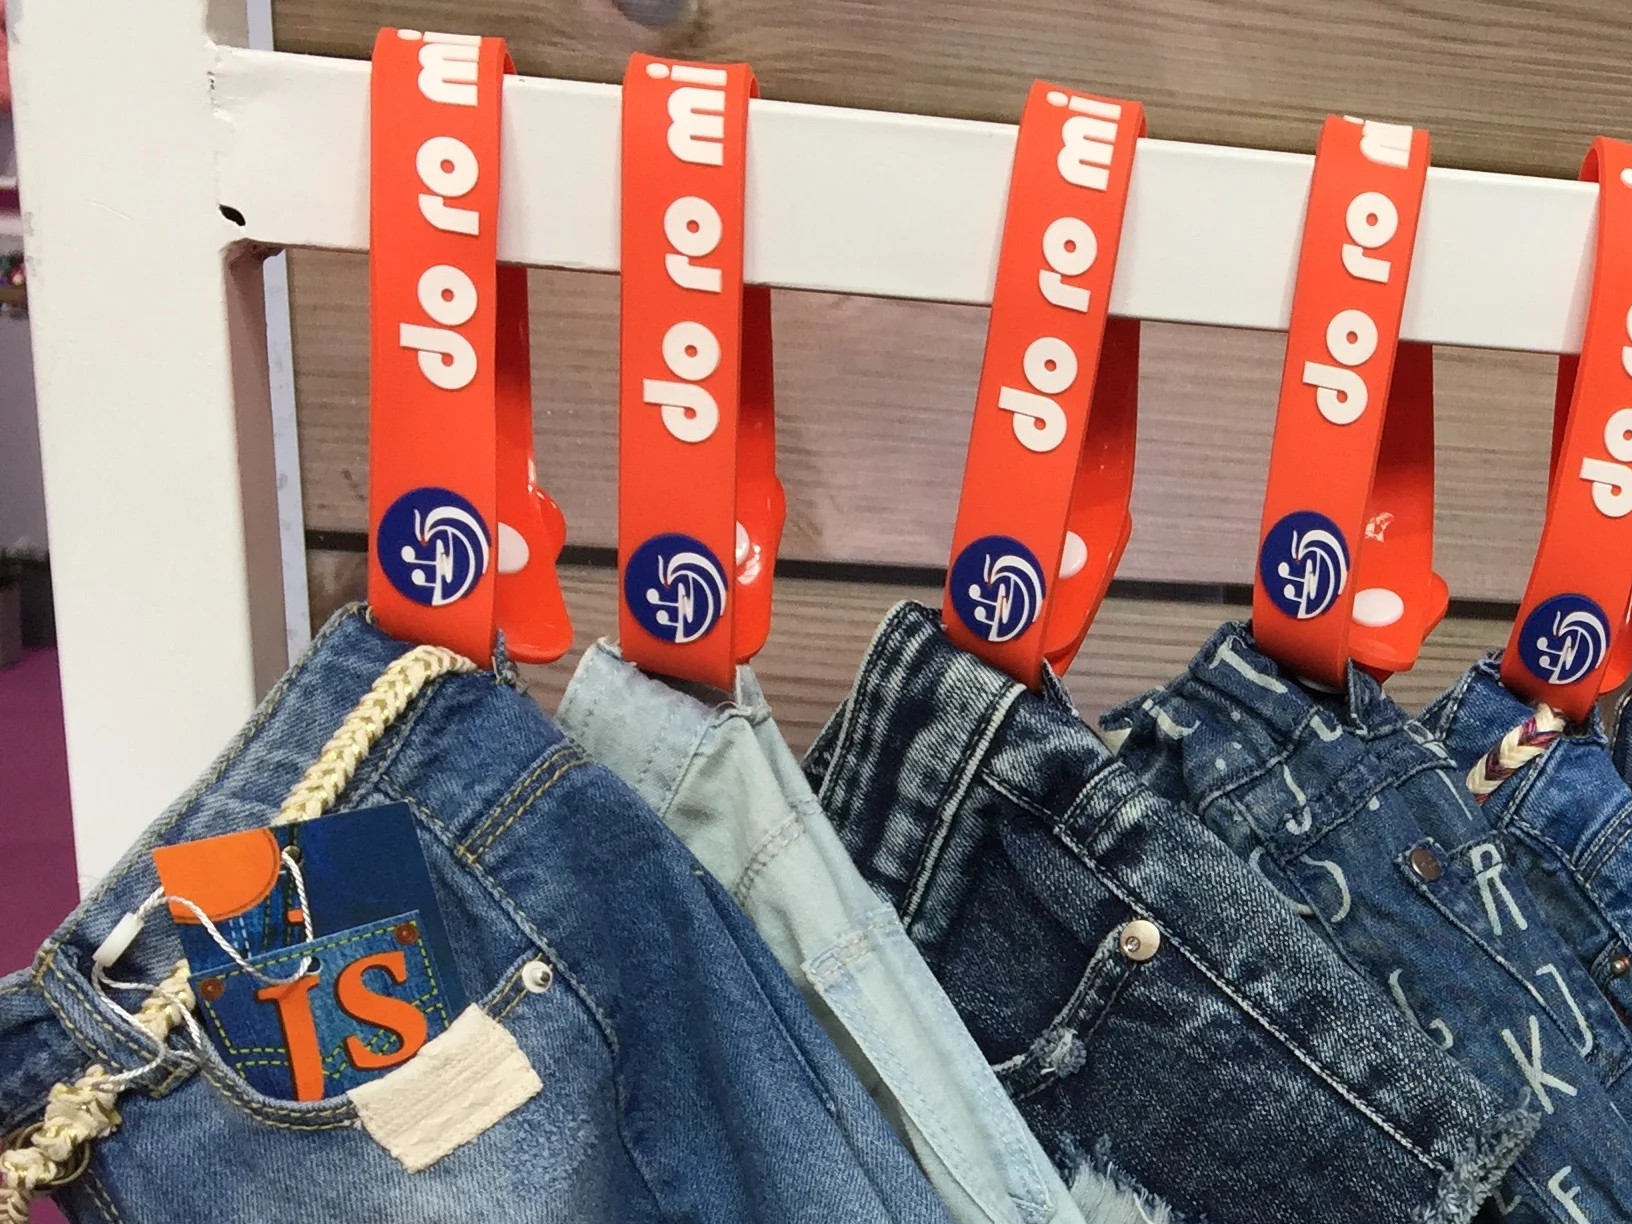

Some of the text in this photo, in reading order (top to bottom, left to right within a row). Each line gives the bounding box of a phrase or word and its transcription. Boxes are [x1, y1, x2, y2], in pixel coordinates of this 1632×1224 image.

[397, 28, 481, 389] do ro mi
[643, 63, 727, 442] do ro mi
[998, 91, 1122, 451] do ro mi
[1303, 310, 1378, 424] do
[1342, 192, 1398, 282] ro
